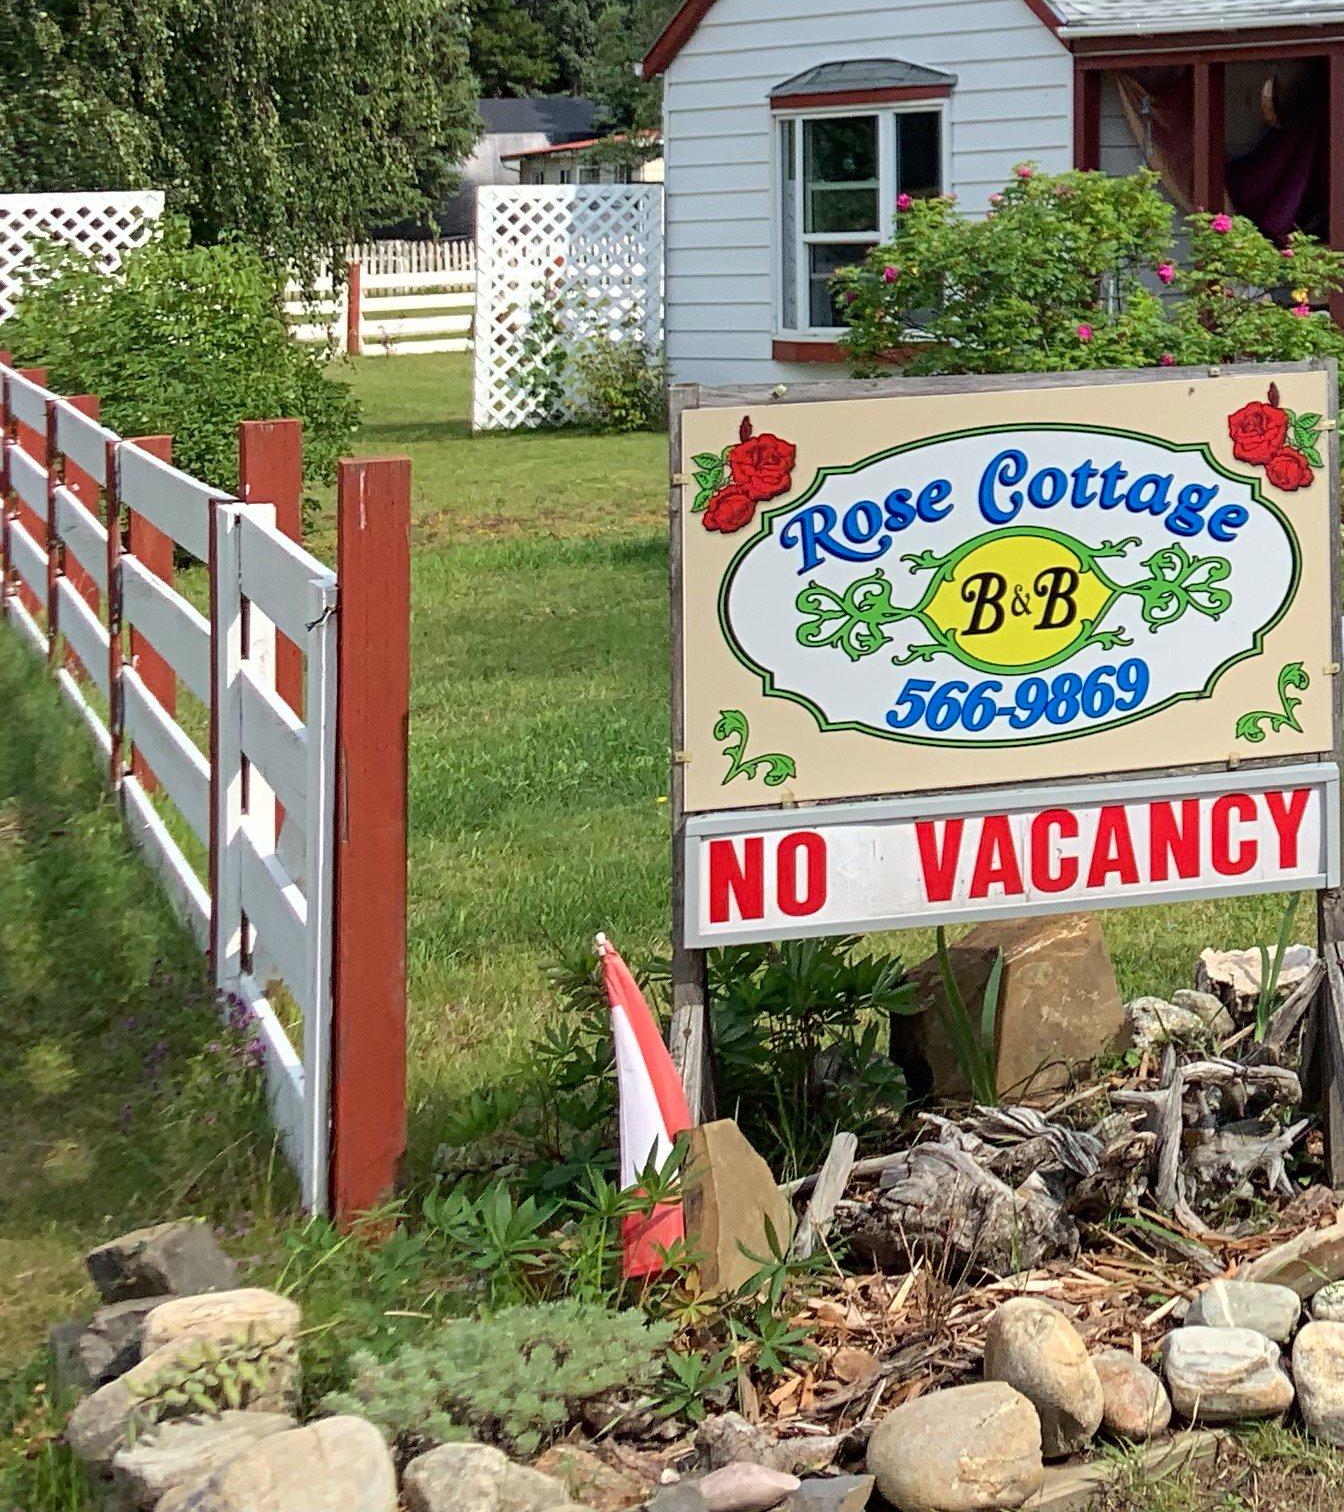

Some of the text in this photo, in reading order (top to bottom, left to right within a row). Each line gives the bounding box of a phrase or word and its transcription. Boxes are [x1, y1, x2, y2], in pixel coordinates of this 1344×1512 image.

[780, 449, 1250, 575] Rose Cottage
[961, 566, 1077, 636] B&B
[885, 657, 1150, 732] 566-9869
[708, 788, 1311, 922] NO VACANCY
